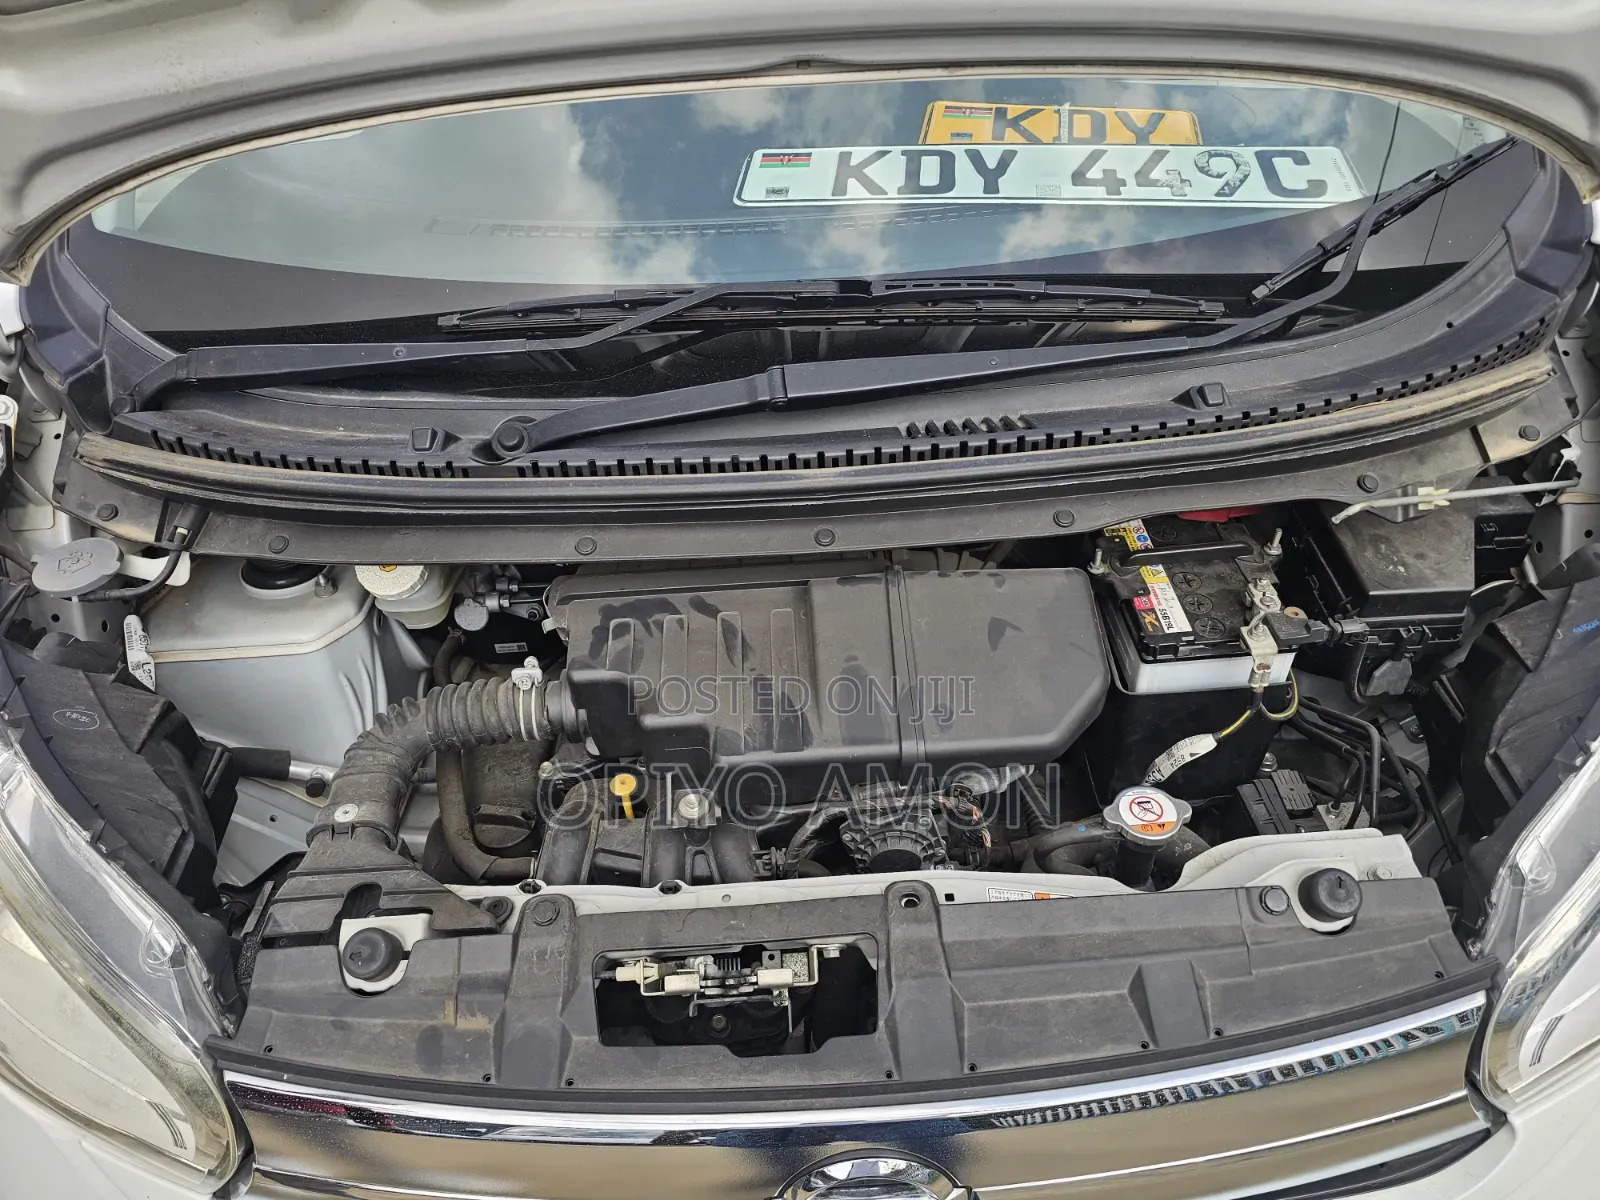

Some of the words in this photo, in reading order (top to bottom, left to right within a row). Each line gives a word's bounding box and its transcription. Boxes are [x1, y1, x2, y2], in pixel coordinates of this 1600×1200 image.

[989, 106, 1168, 145] KDY
[831, 149, 1018, 197] KDY
[1070, 148, 1328, 199] 449C
